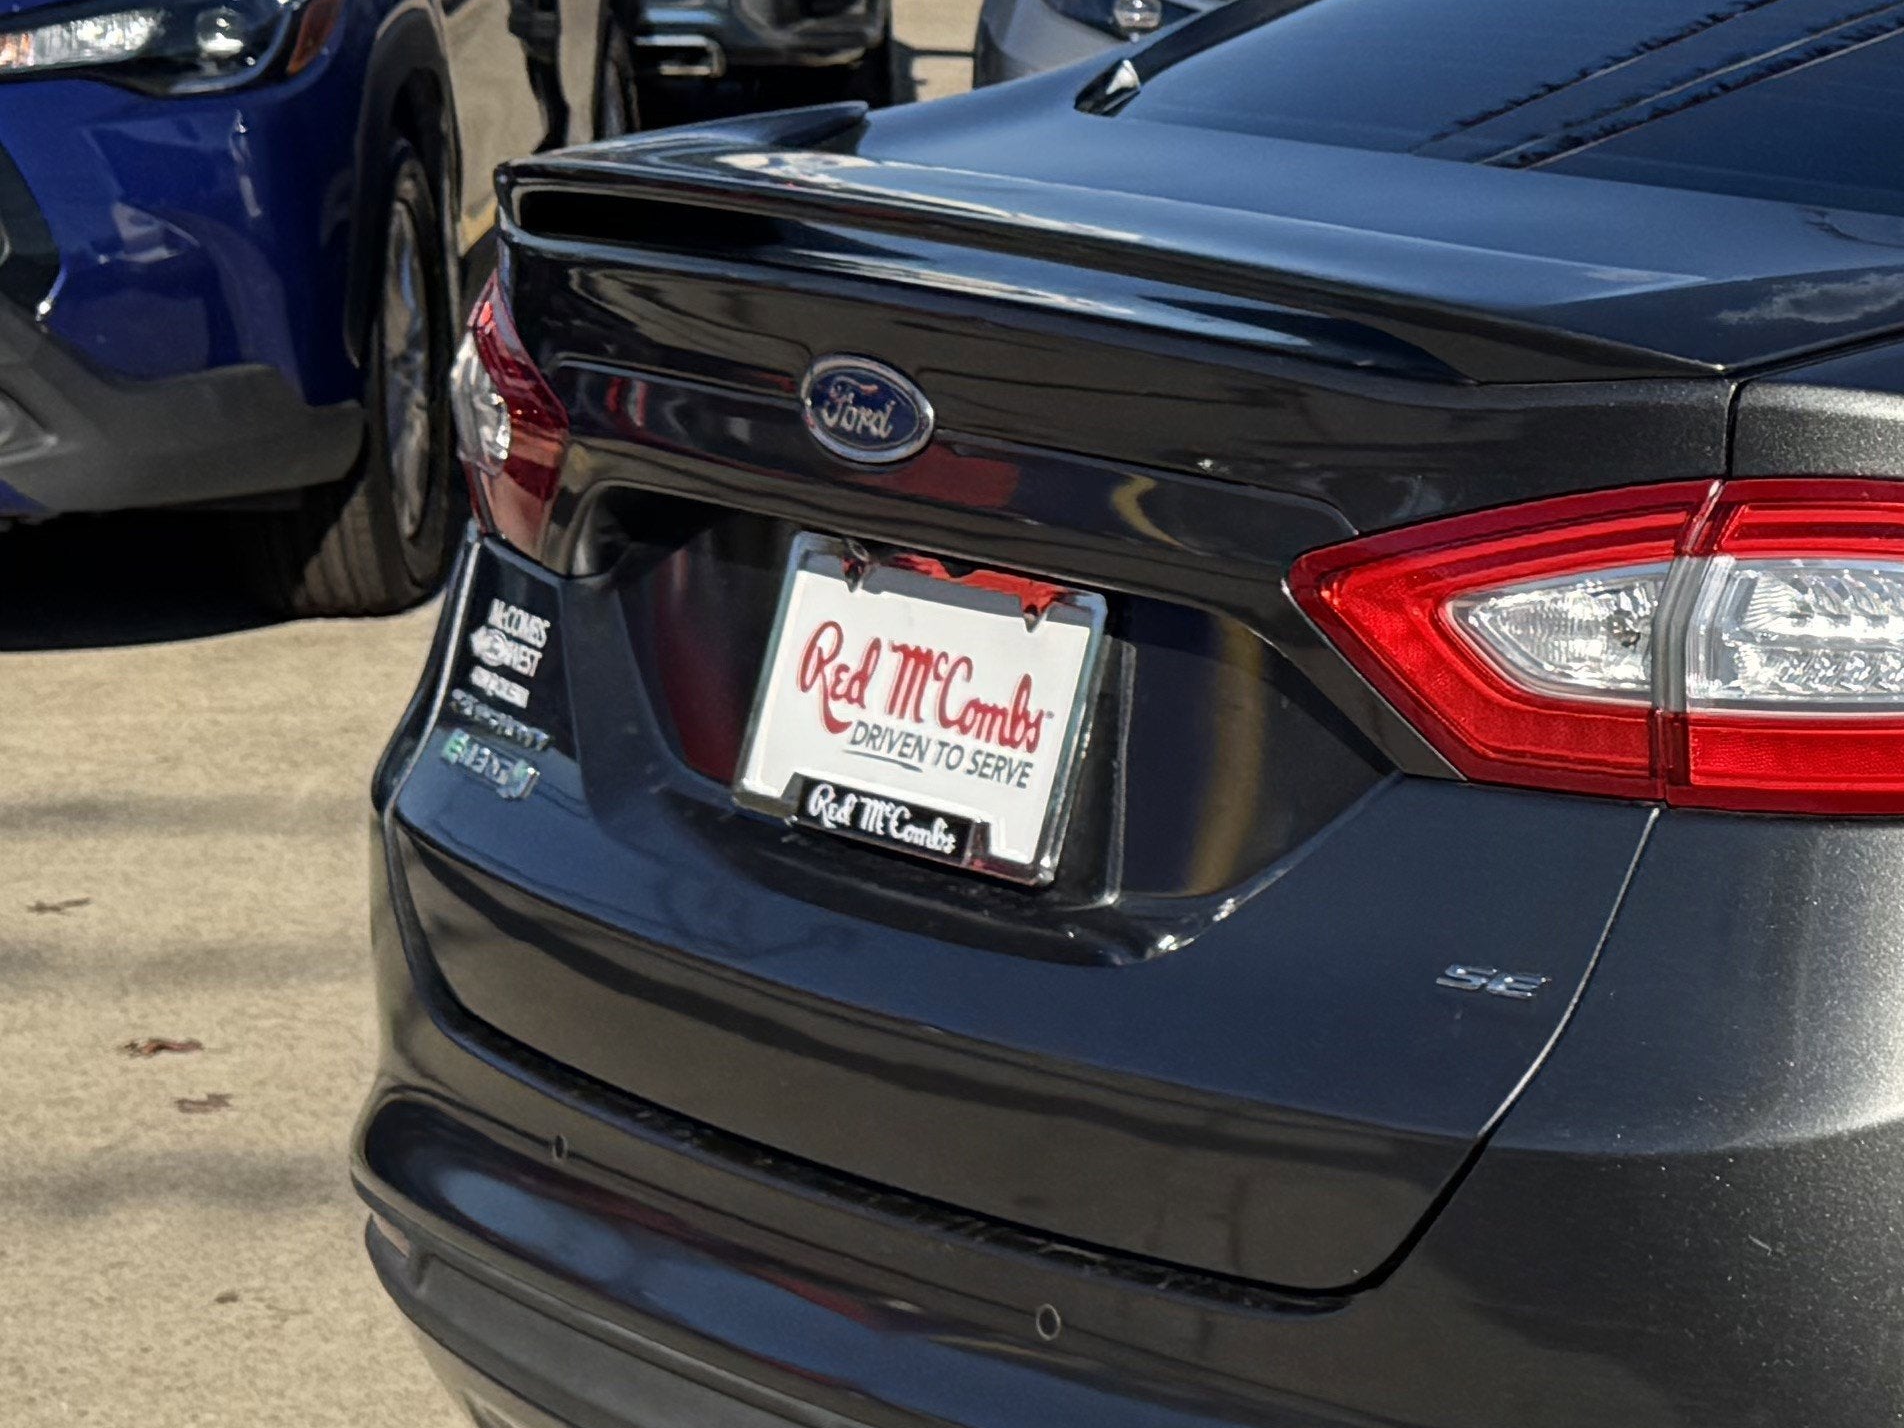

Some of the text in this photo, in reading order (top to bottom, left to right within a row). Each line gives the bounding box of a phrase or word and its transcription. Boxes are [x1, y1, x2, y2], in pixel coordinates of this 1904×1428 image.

[820, 375, 898, 440] Ford
[796, 620, 1044, 754] Red McCombs
[850, 720, 1034, 789] DRIVEN TO SERVE
[807, 783, 858, 829] Red
[1436, 964, 1552, 1000] SE
